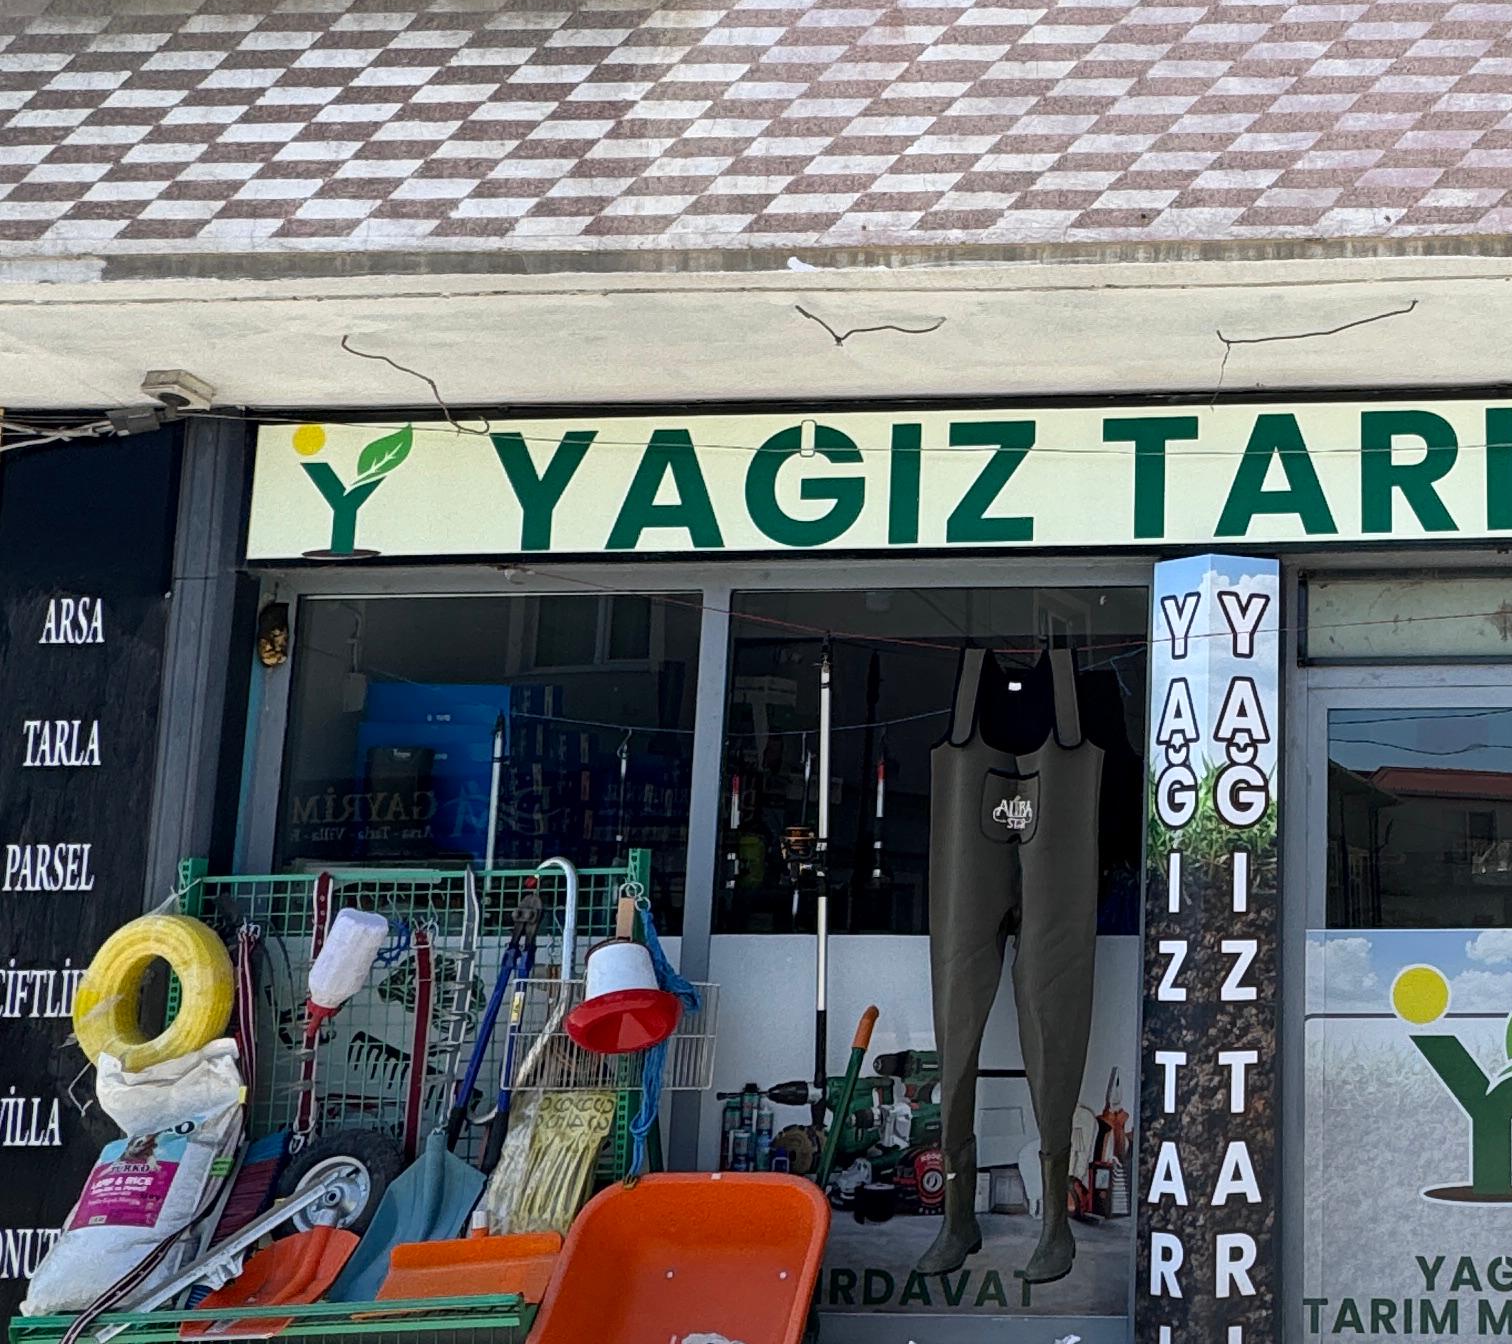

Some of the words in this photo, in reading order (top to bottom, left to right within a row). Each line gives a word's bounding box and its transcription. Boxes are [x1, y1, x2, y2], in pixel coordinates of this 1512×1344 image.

[38, 597, 105, 644] ARSA
[22, 720, 101, 767] TARLA
[1, 843, 95, 892] PARSEL
[0, 958, 87, 1018] İFTLİ
[0, 1228, 62, 1279] NUT
[1302, 1297, 1459, 1335] TARIM
